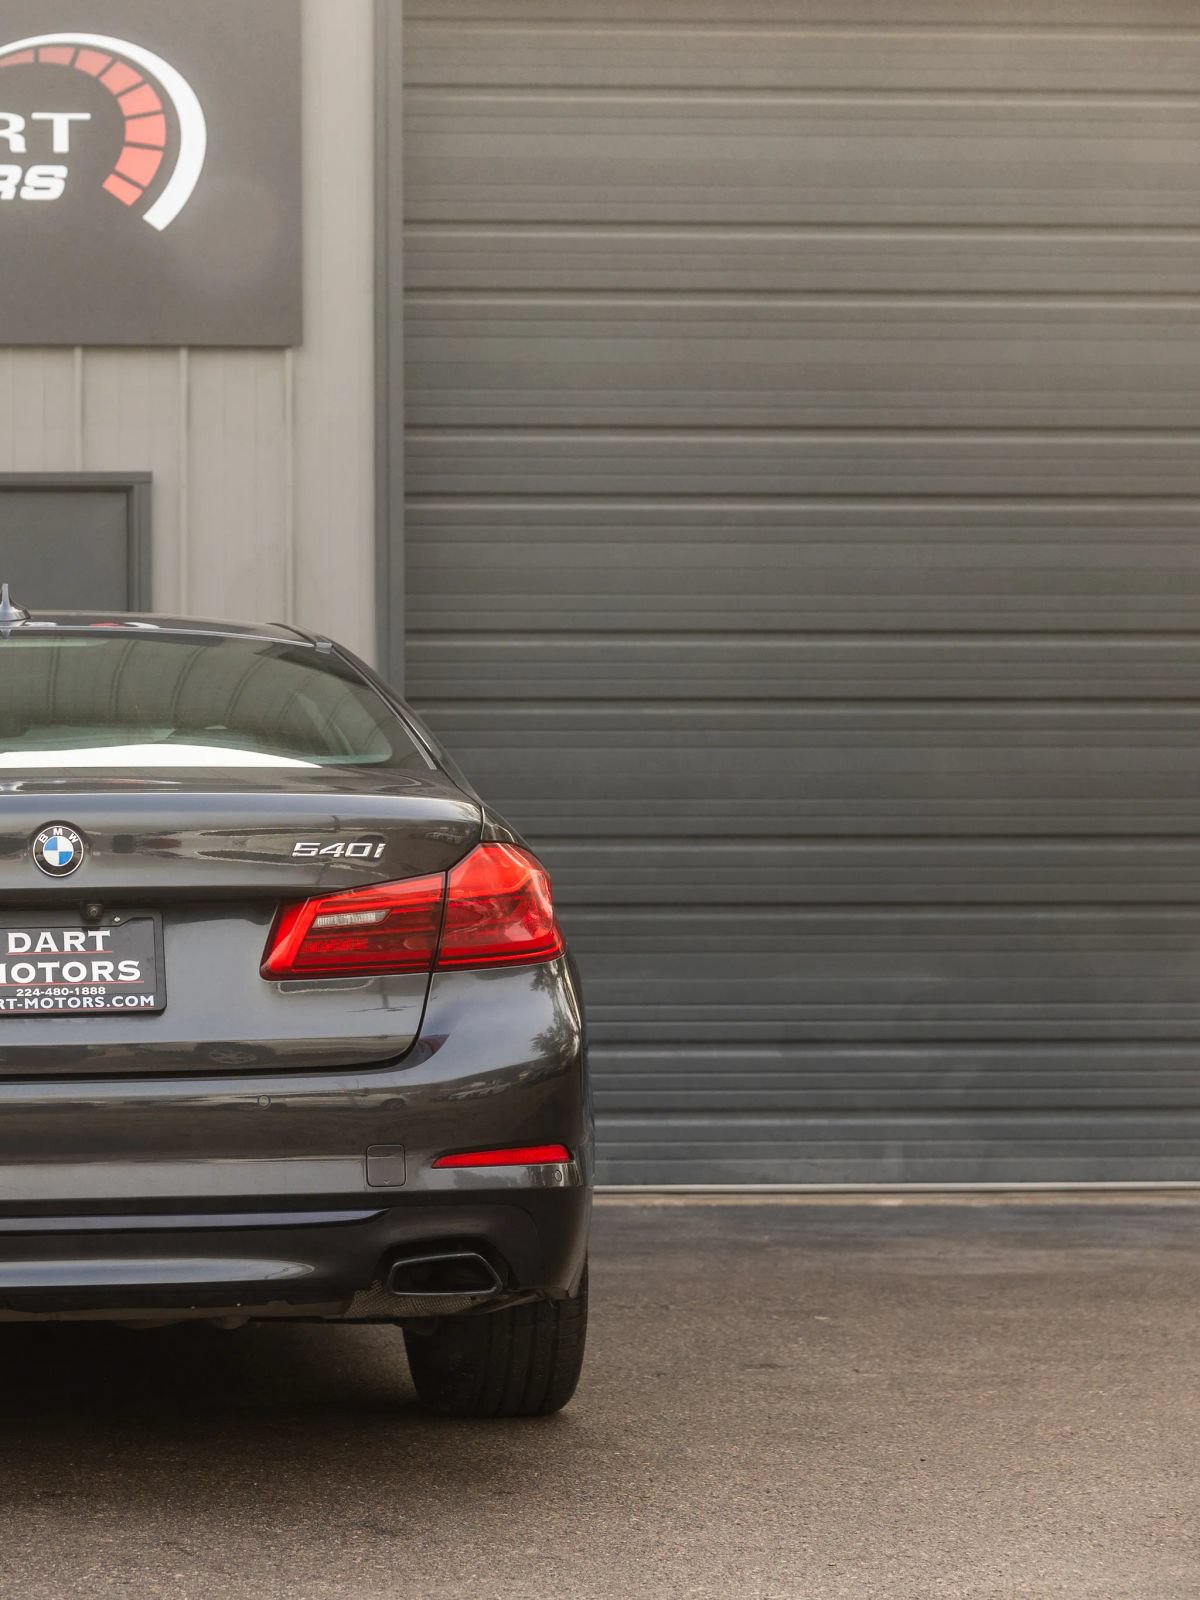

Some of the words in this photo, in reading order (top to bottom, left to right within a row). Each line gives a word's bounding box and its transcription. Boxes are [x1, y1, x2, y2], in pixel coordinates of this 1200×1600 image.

[38, 827, 79, 844] BMW
[292, 842, 386, 858] 540i
[7, 930, 111, 953] DART
[16, 987, 106, 996] 224-480-1888
